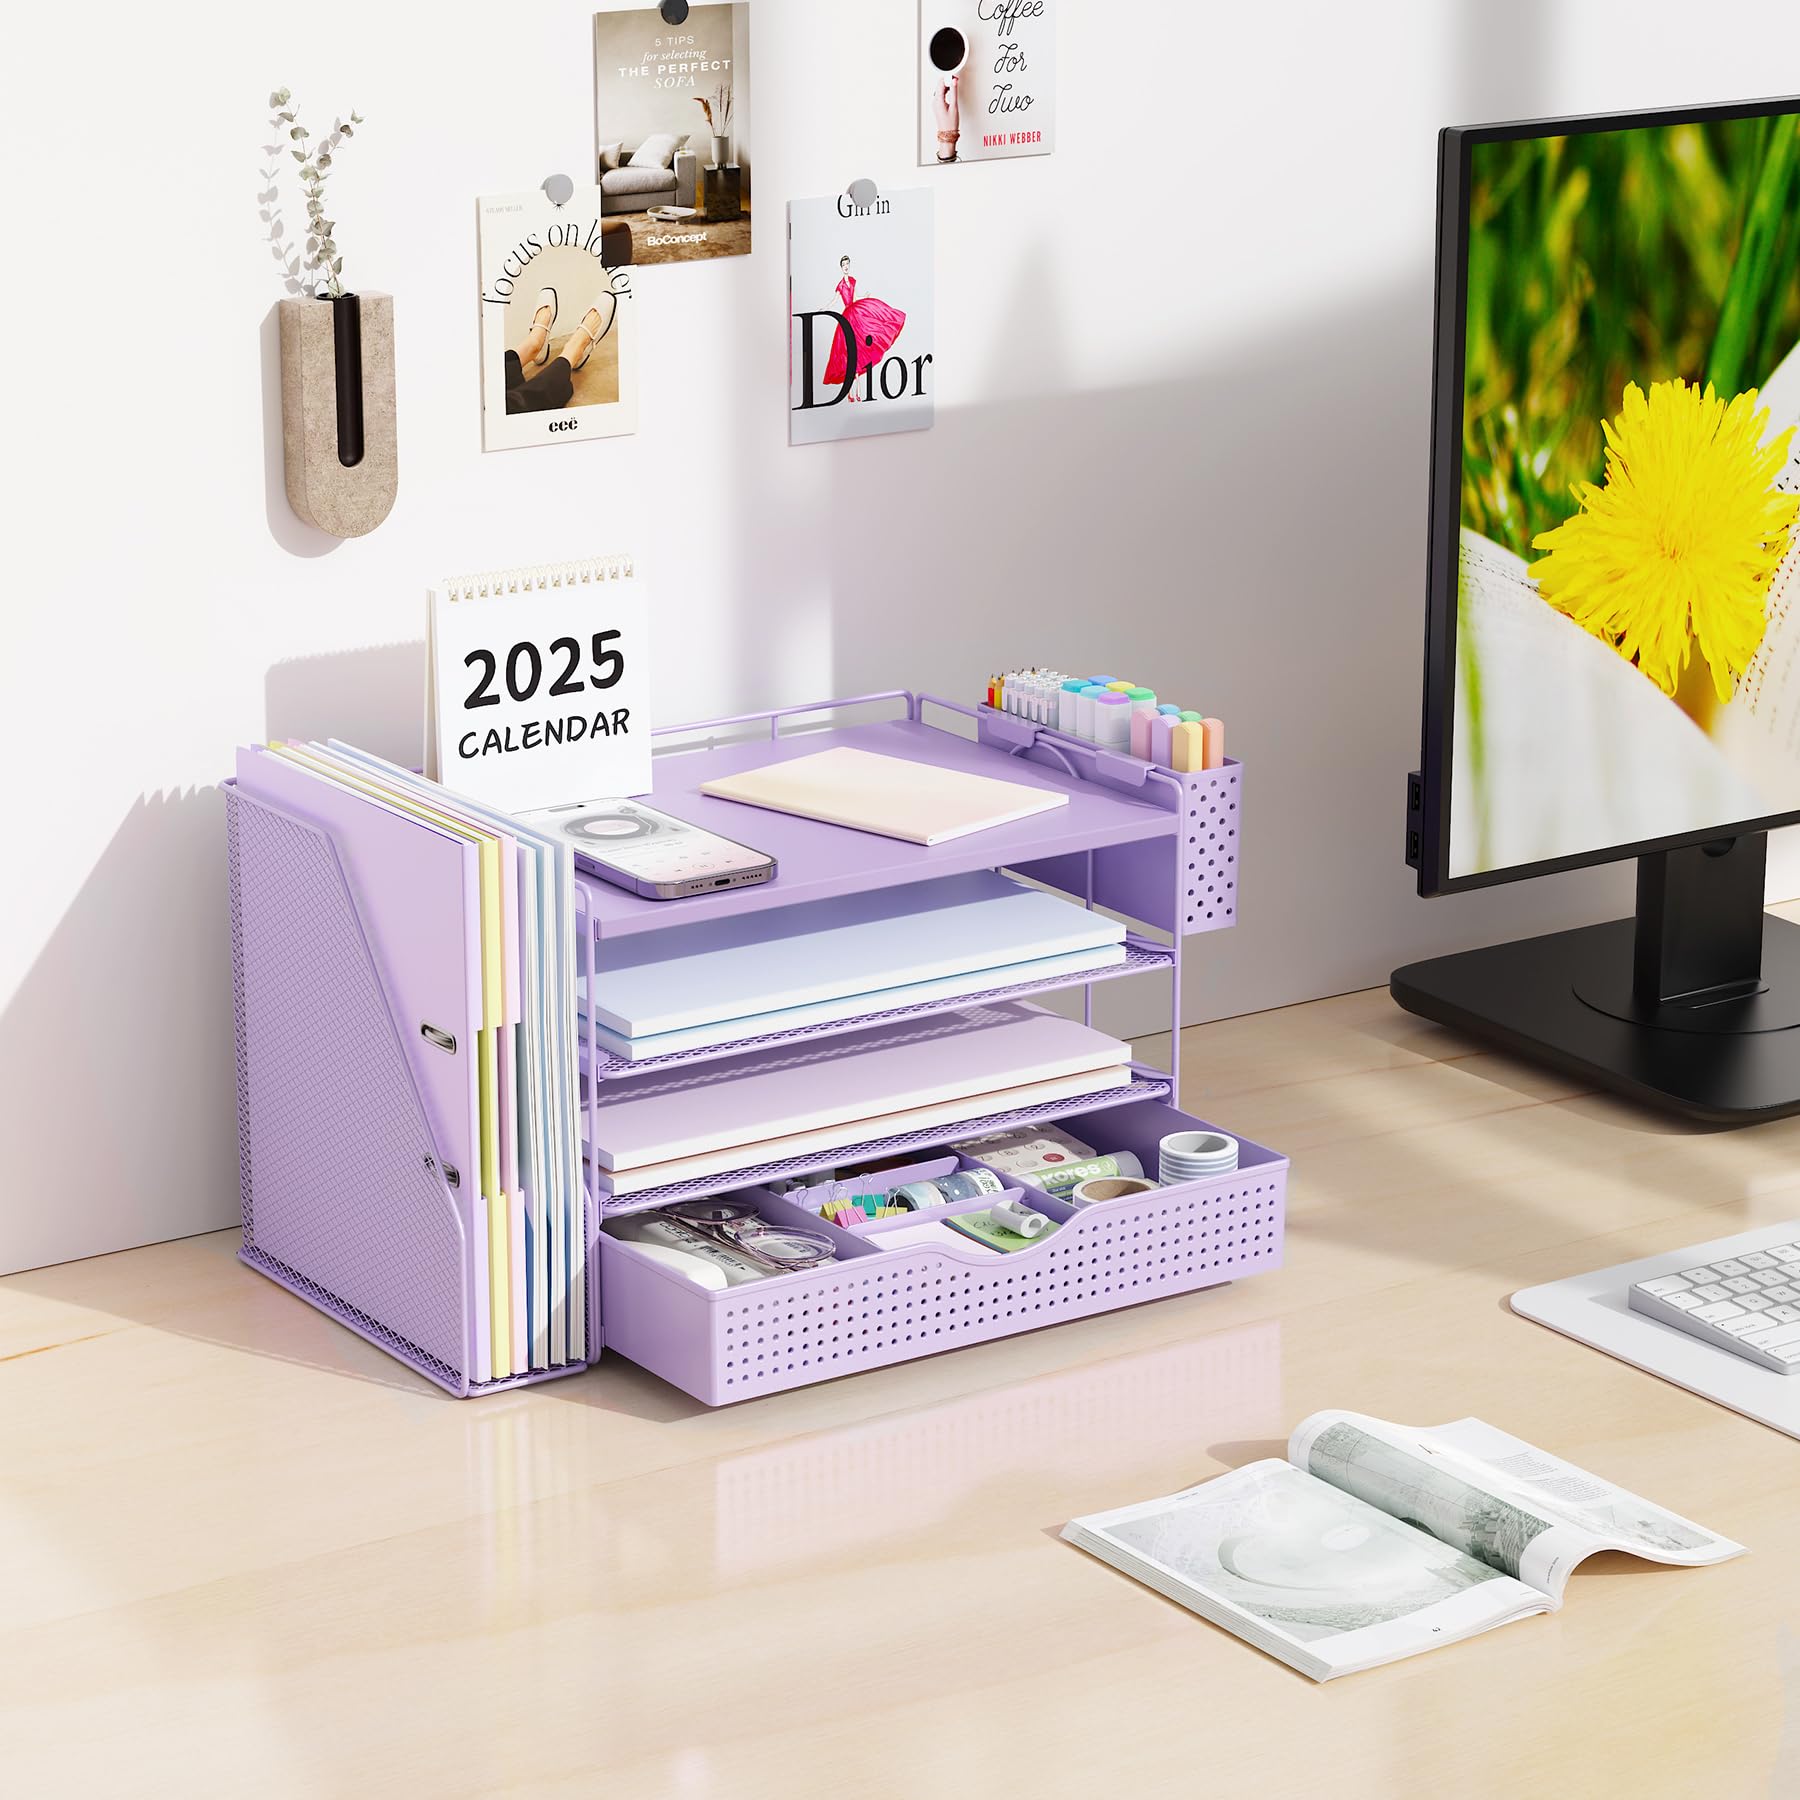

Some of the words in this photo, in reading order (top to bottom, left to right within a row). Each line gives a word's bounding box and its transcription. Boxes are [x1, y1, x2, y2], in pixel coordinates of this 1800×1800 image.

[977, 0, 1045, 36] Coffee
[655, 38, 662, 47] 5
[665, 35, 695, 46] TIPS
[618, 66, 650, 78] THE
[657, 60, 732, 75] PERFECT
[642, 52, 658, 65] for
[659, 49, 707, 61] selecting
[993, 43, 1028, 74] For
[653, 77, 696, 89] SOFA
[988, 83, 1035, 114] Two
[983, 134, 1006, 147] NIKKI
[1009, 131, 1041, 145] WEBBER
[876, 195, 890, 214] in
[647, 231, 708, 247] BoConcept
[482, 233, 543, 305] focus
[548, 222, 579, 248] on
[792, 310, 933, 411] Dior
[463, 629, 624, 710] 2025
[458, 708, 630, 759] CALENDAR
